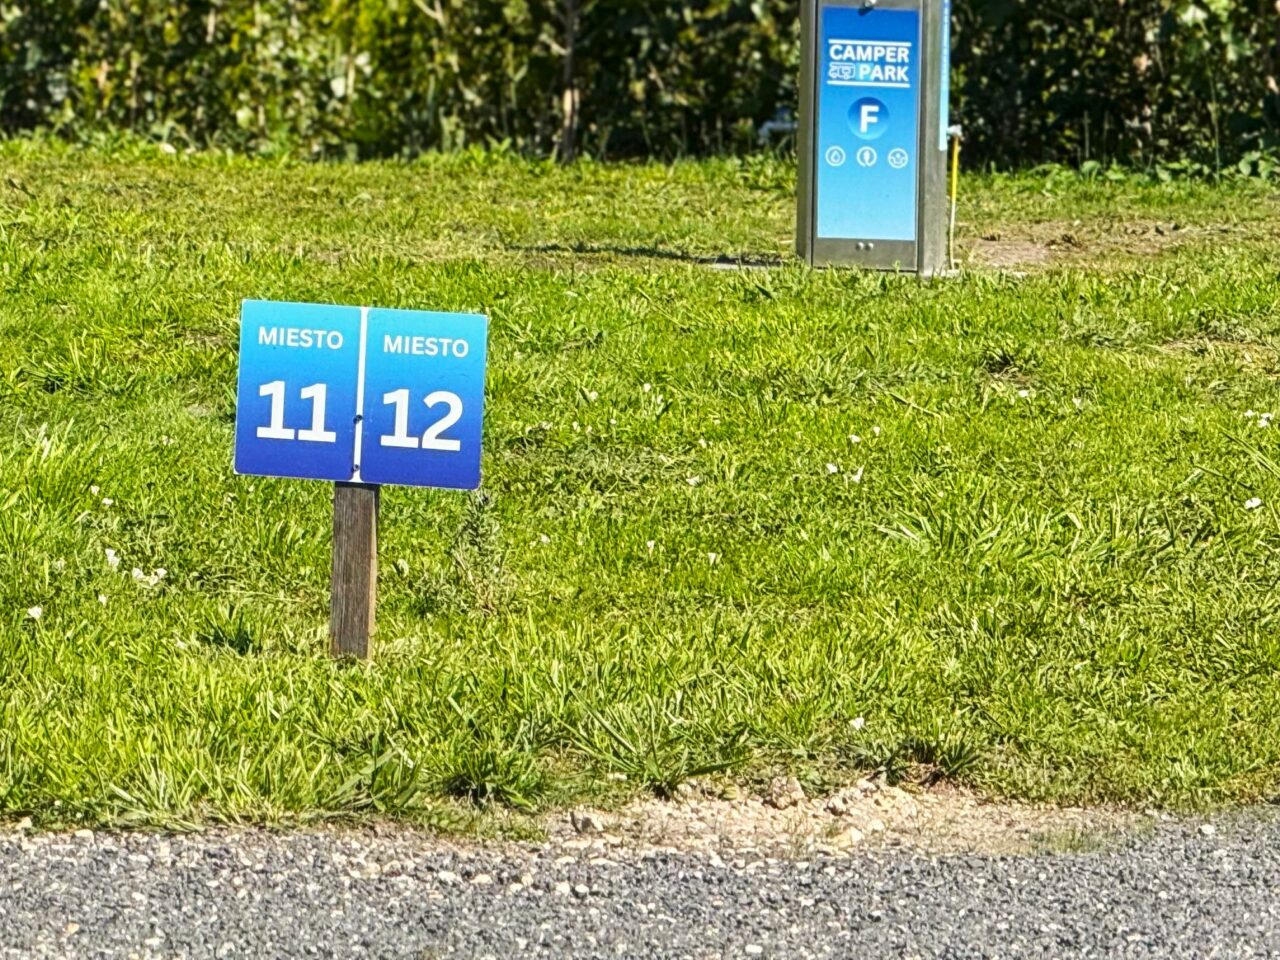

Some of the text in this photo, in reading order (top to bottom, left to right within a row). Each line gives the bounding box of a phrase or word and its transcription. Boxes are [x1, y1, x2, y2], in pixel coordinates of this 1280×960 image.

[828, 43, 910, 64] CAMPER
[857, 64, 909, 83] PARK
[859, 104, 880, 134] F
[257, 326, 344, 350] MIESTO
[383, 334, 470, 358] MIESTO
[256, 380, 337, 443] 11
[380, 388, 464, 452] 12
